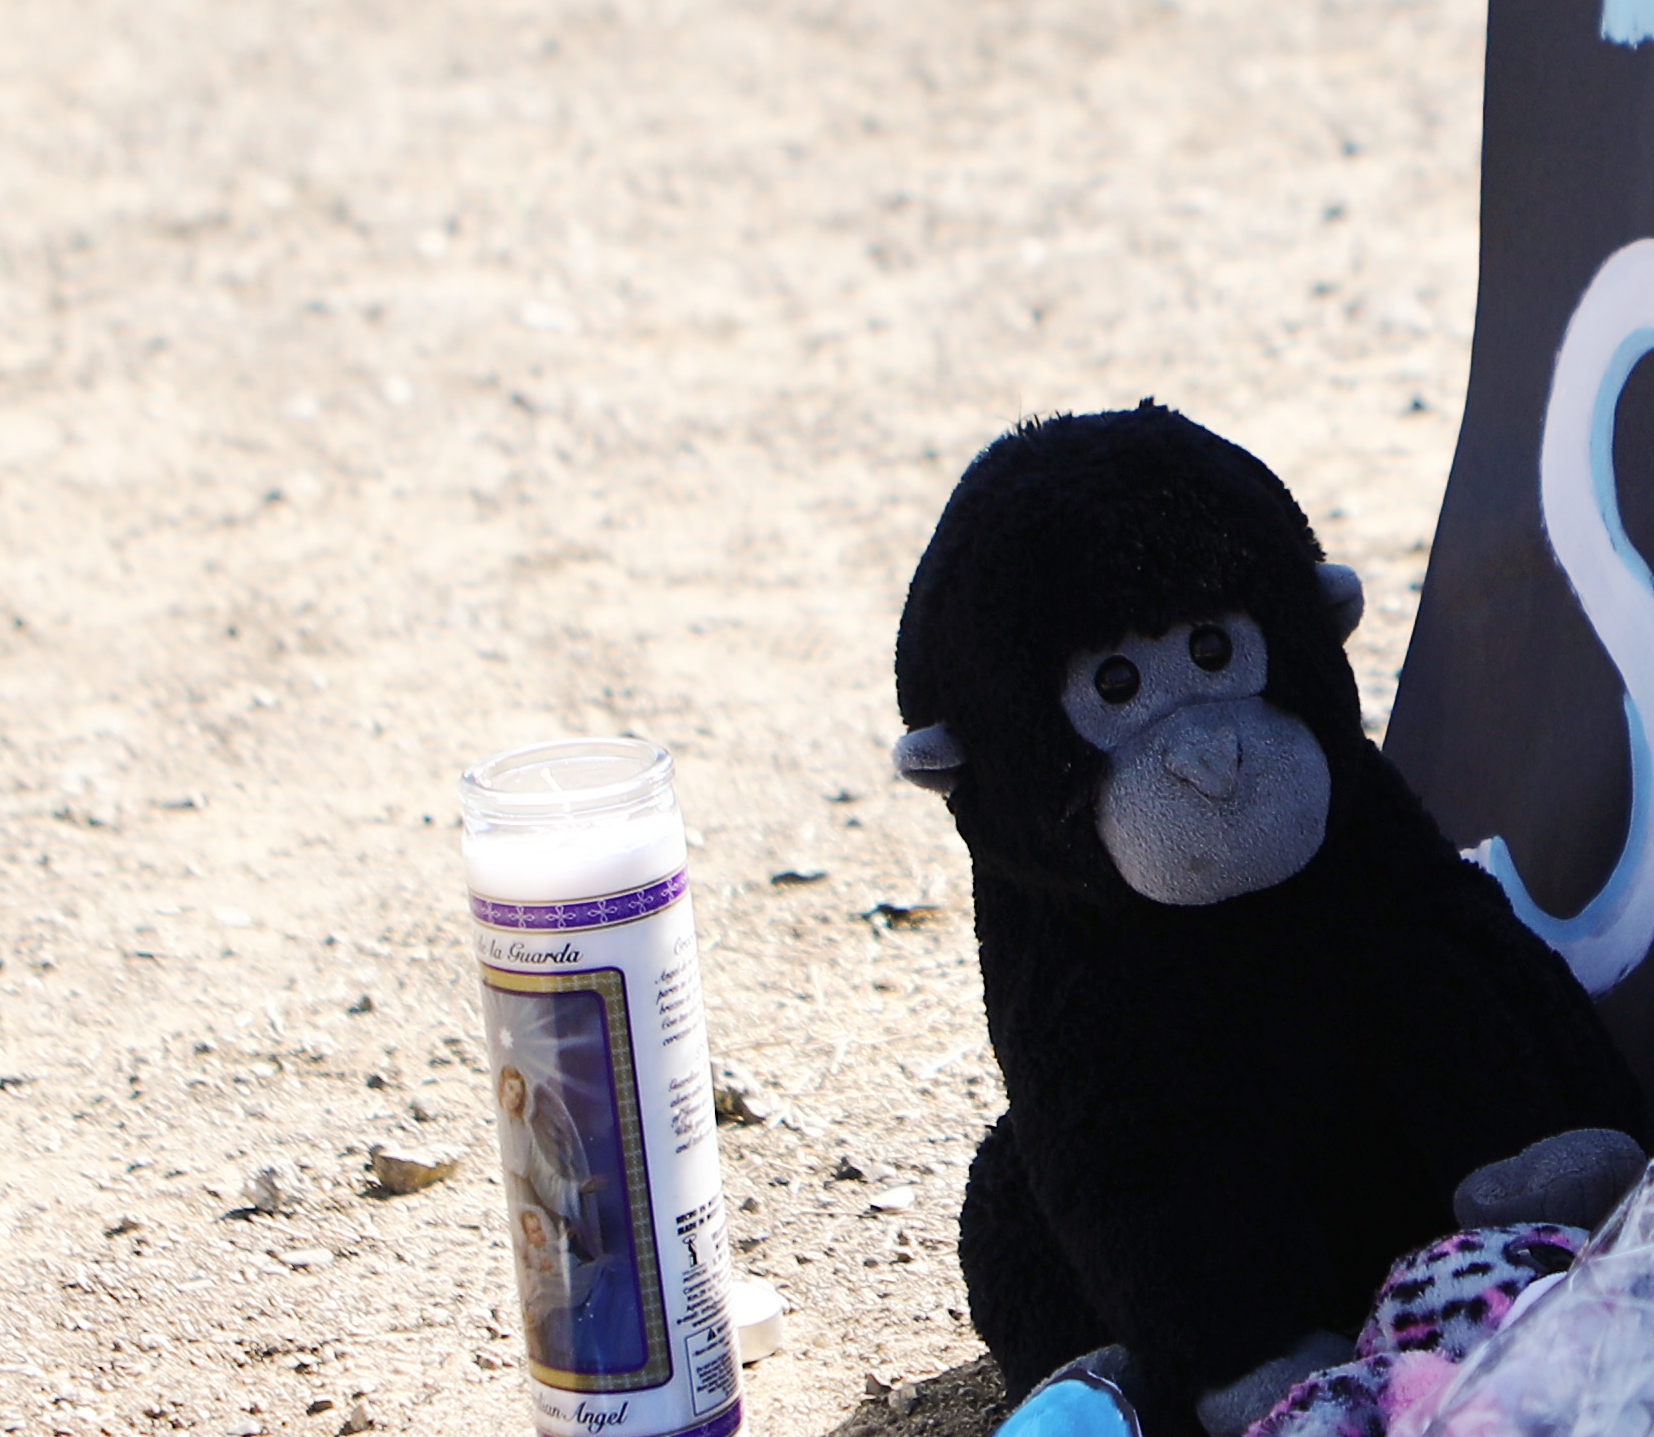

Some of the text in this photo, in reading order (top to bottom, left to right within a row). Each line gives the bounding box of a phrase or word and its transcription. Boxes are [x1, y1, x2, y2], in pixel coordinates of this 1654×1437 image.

[490, 939, 503, 961] la
[507, 942, 584, 965] Guarda
[565, 1400, 630, 1435] Angel
